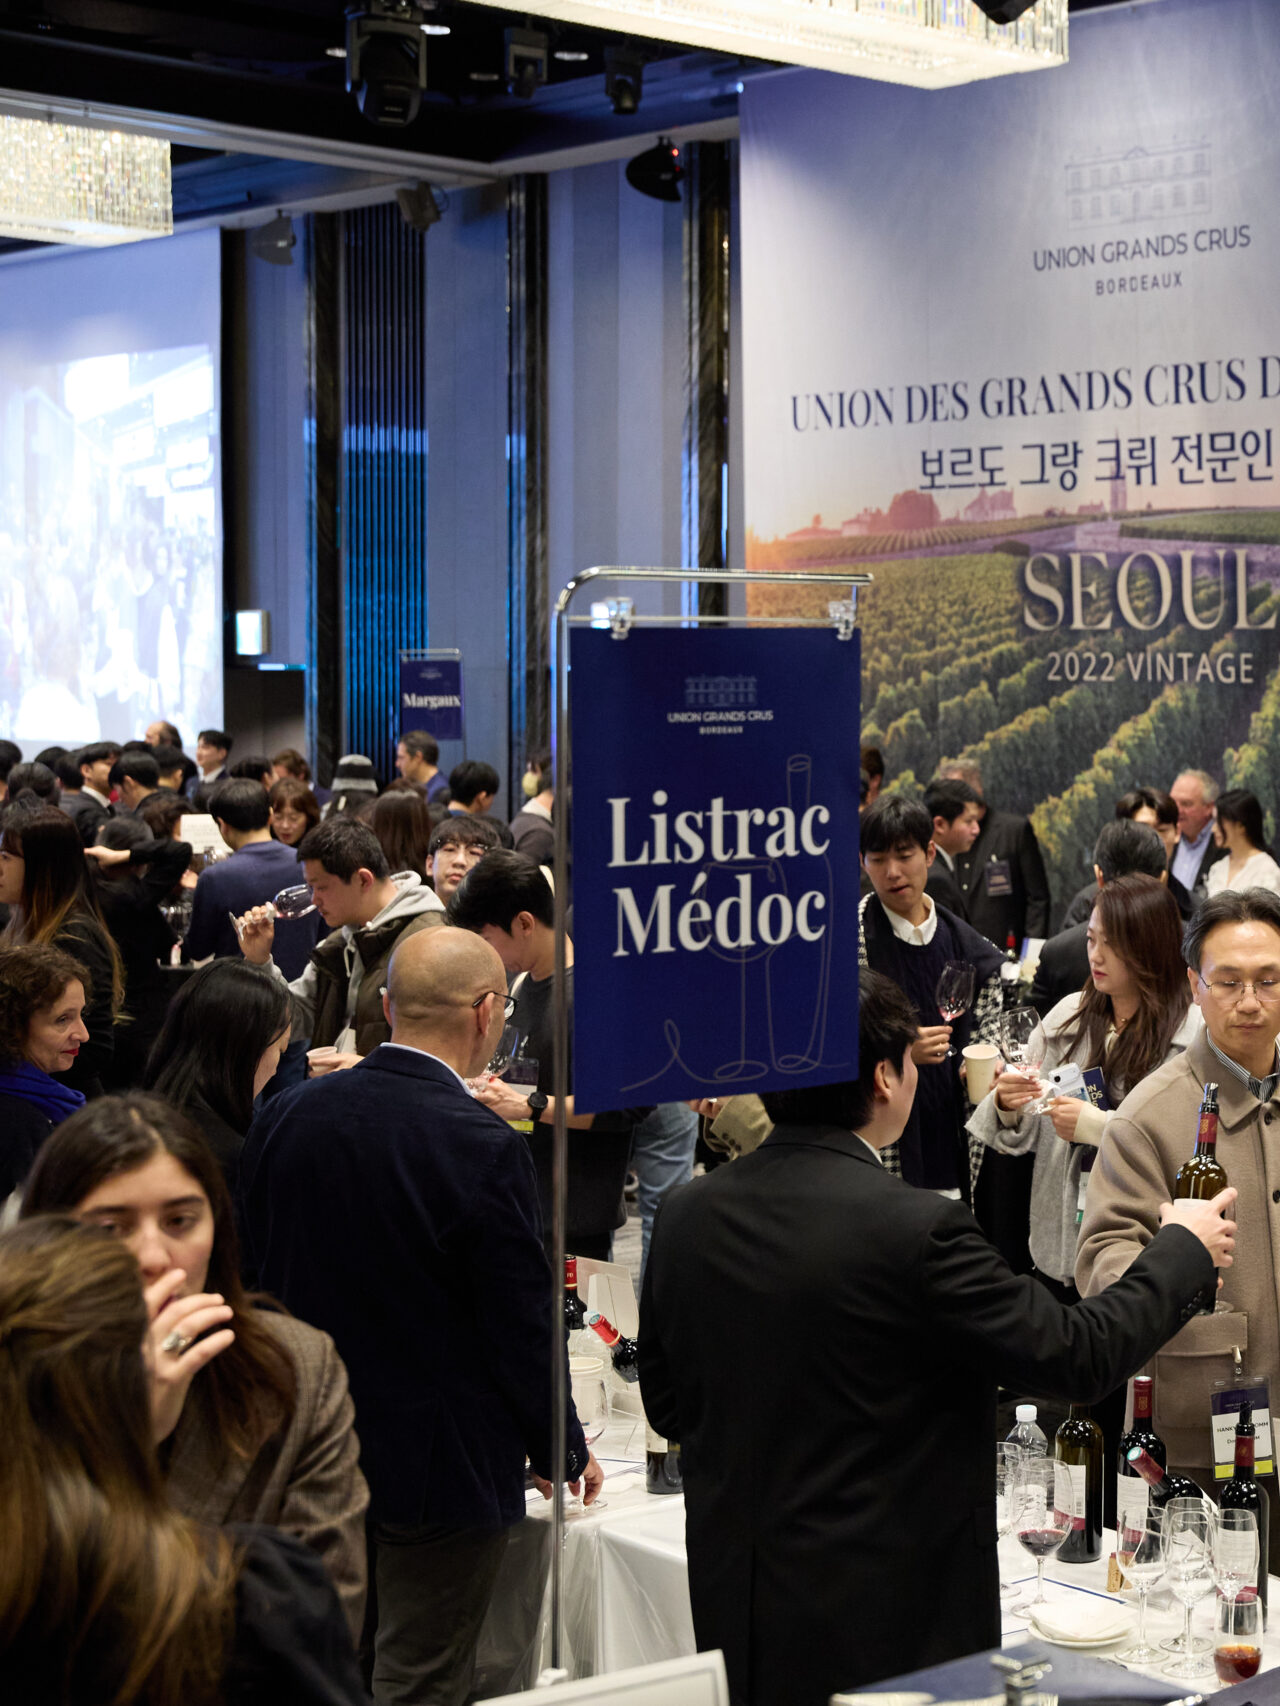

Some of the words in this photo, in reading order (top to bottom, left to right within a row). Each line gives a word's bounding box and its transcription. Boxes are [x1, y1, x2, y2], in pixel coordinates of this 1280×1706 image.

[1033, 244, 1096, 272] UNION
[1100, 232, 1189, 264] GRANDS
[1193, 225, 1252, 252] CRUS
[1095, 271, 1183, 296] BORDEAUX
[791, 387, 895, 433] UNION
[905, 381, 970, 424] DES
[979, 367, 1134, 420] GRANDS
[1144, 357, 1247, 408] CRUS
[919, 445, 1008, 491] 보르도
[1019, 441, 1084, 492] 그랑
[1094, 435, 1158, 487] 크뤼
[1171, 427, 1275, 485] 전문인
[1023, 548, 1278, 632] SEOUL
[1047, 652, 1117, 682] 2022
[1126, 652, 1255, 684] VINTAGE
[403, 693, 461, 710] Margaux
[667, 711, 701, 723] UNION
[702, 711, 746, 722] GRANDS
[746, 710, 773, 721] CRUS
[607, 790, 831, 867] Listrac
[613, 871, 827, 957] Médoc
